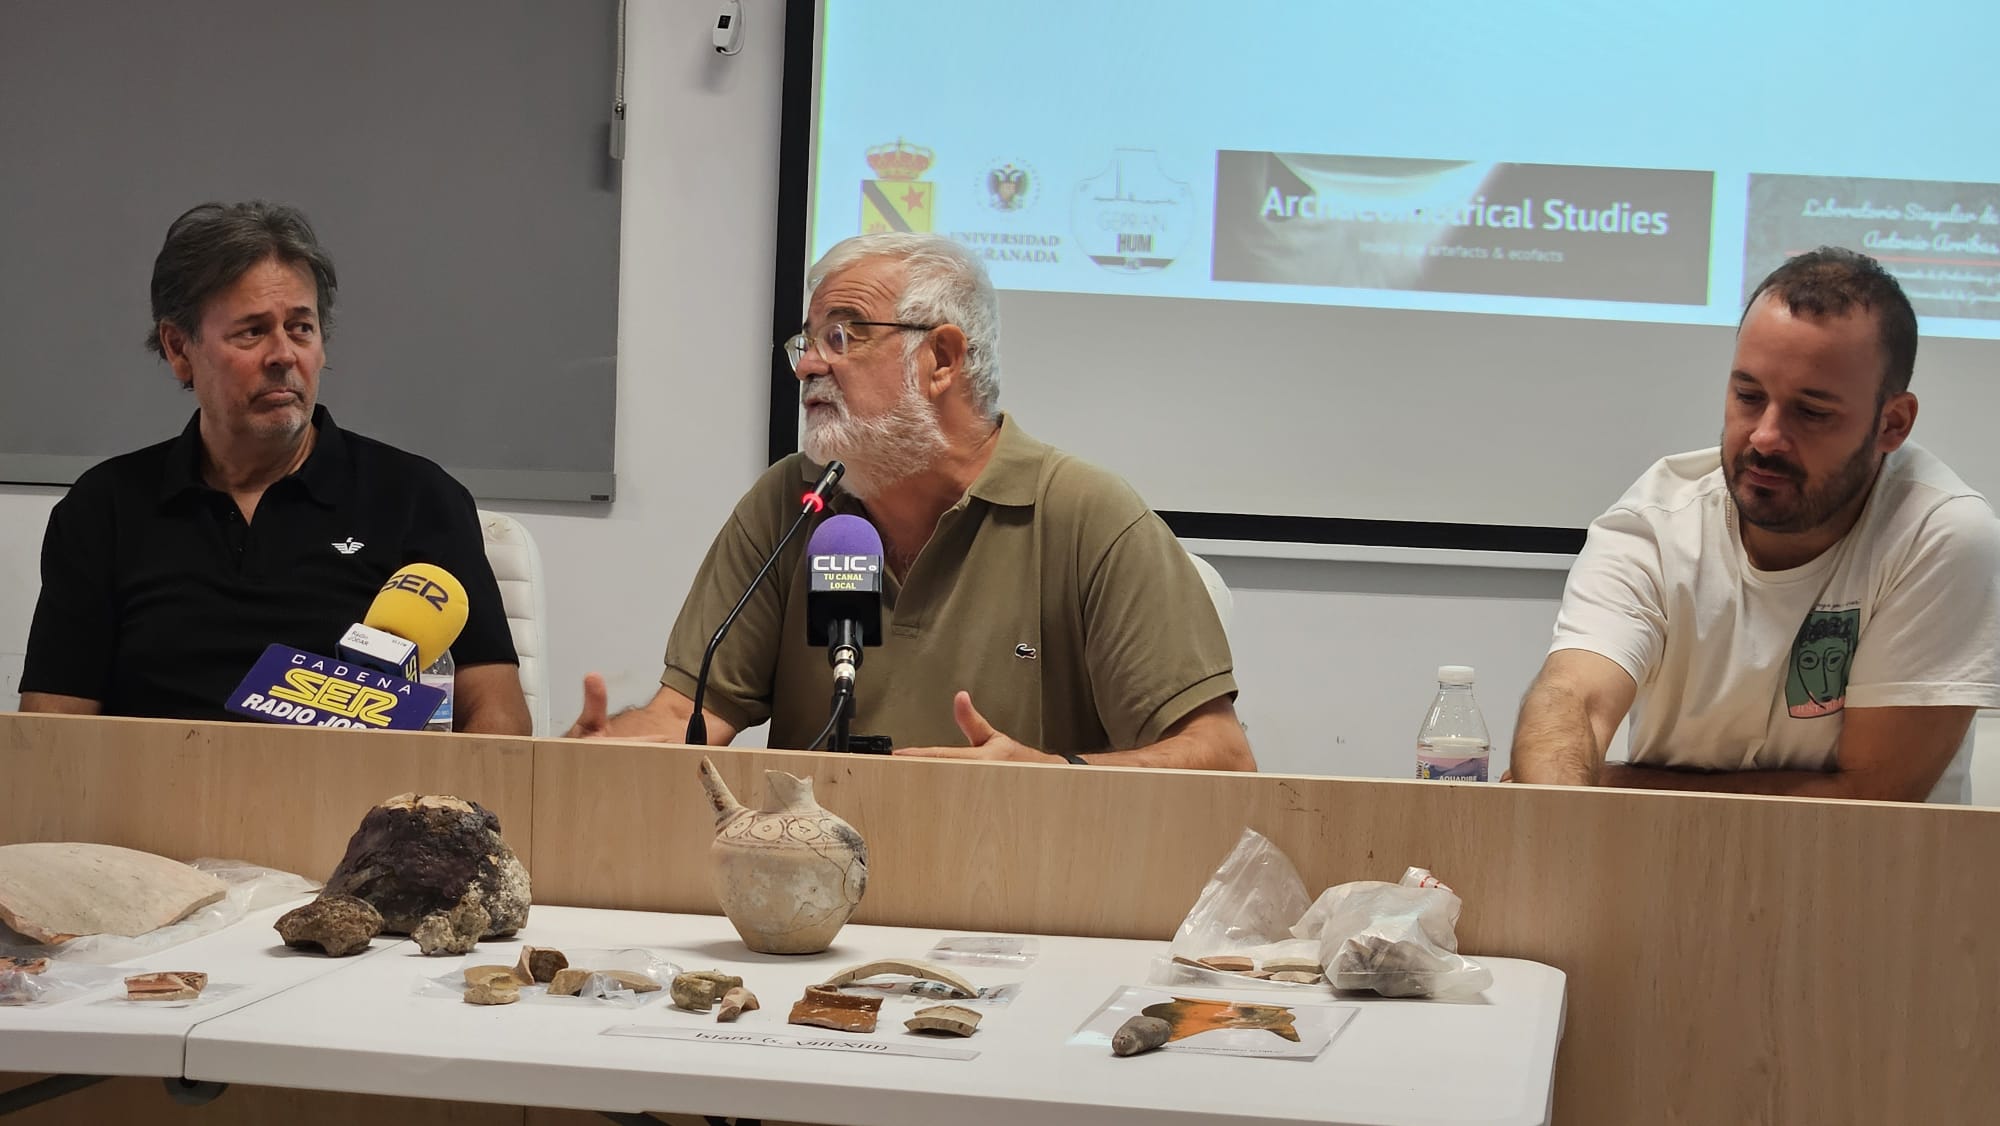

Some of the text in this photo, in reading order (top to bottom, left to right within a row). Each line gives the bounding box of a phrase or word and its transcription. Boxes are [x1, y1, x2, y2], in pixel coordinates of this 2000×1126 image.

[1542, 198, 1669, 236] Studies
[1117, 232, 1152, 253] HUM
[1508, 248, 1564, 263] ecofacts
[381, 574, 449, 612] SER
[824, 573, 863, 581] TU CANAL
[830, 582, 856, 590] LOCAL
[291, 654, 412, 696] CADENA
[241, 693, 317, 725] RADIO
[268, 667, 399, 727] SER
